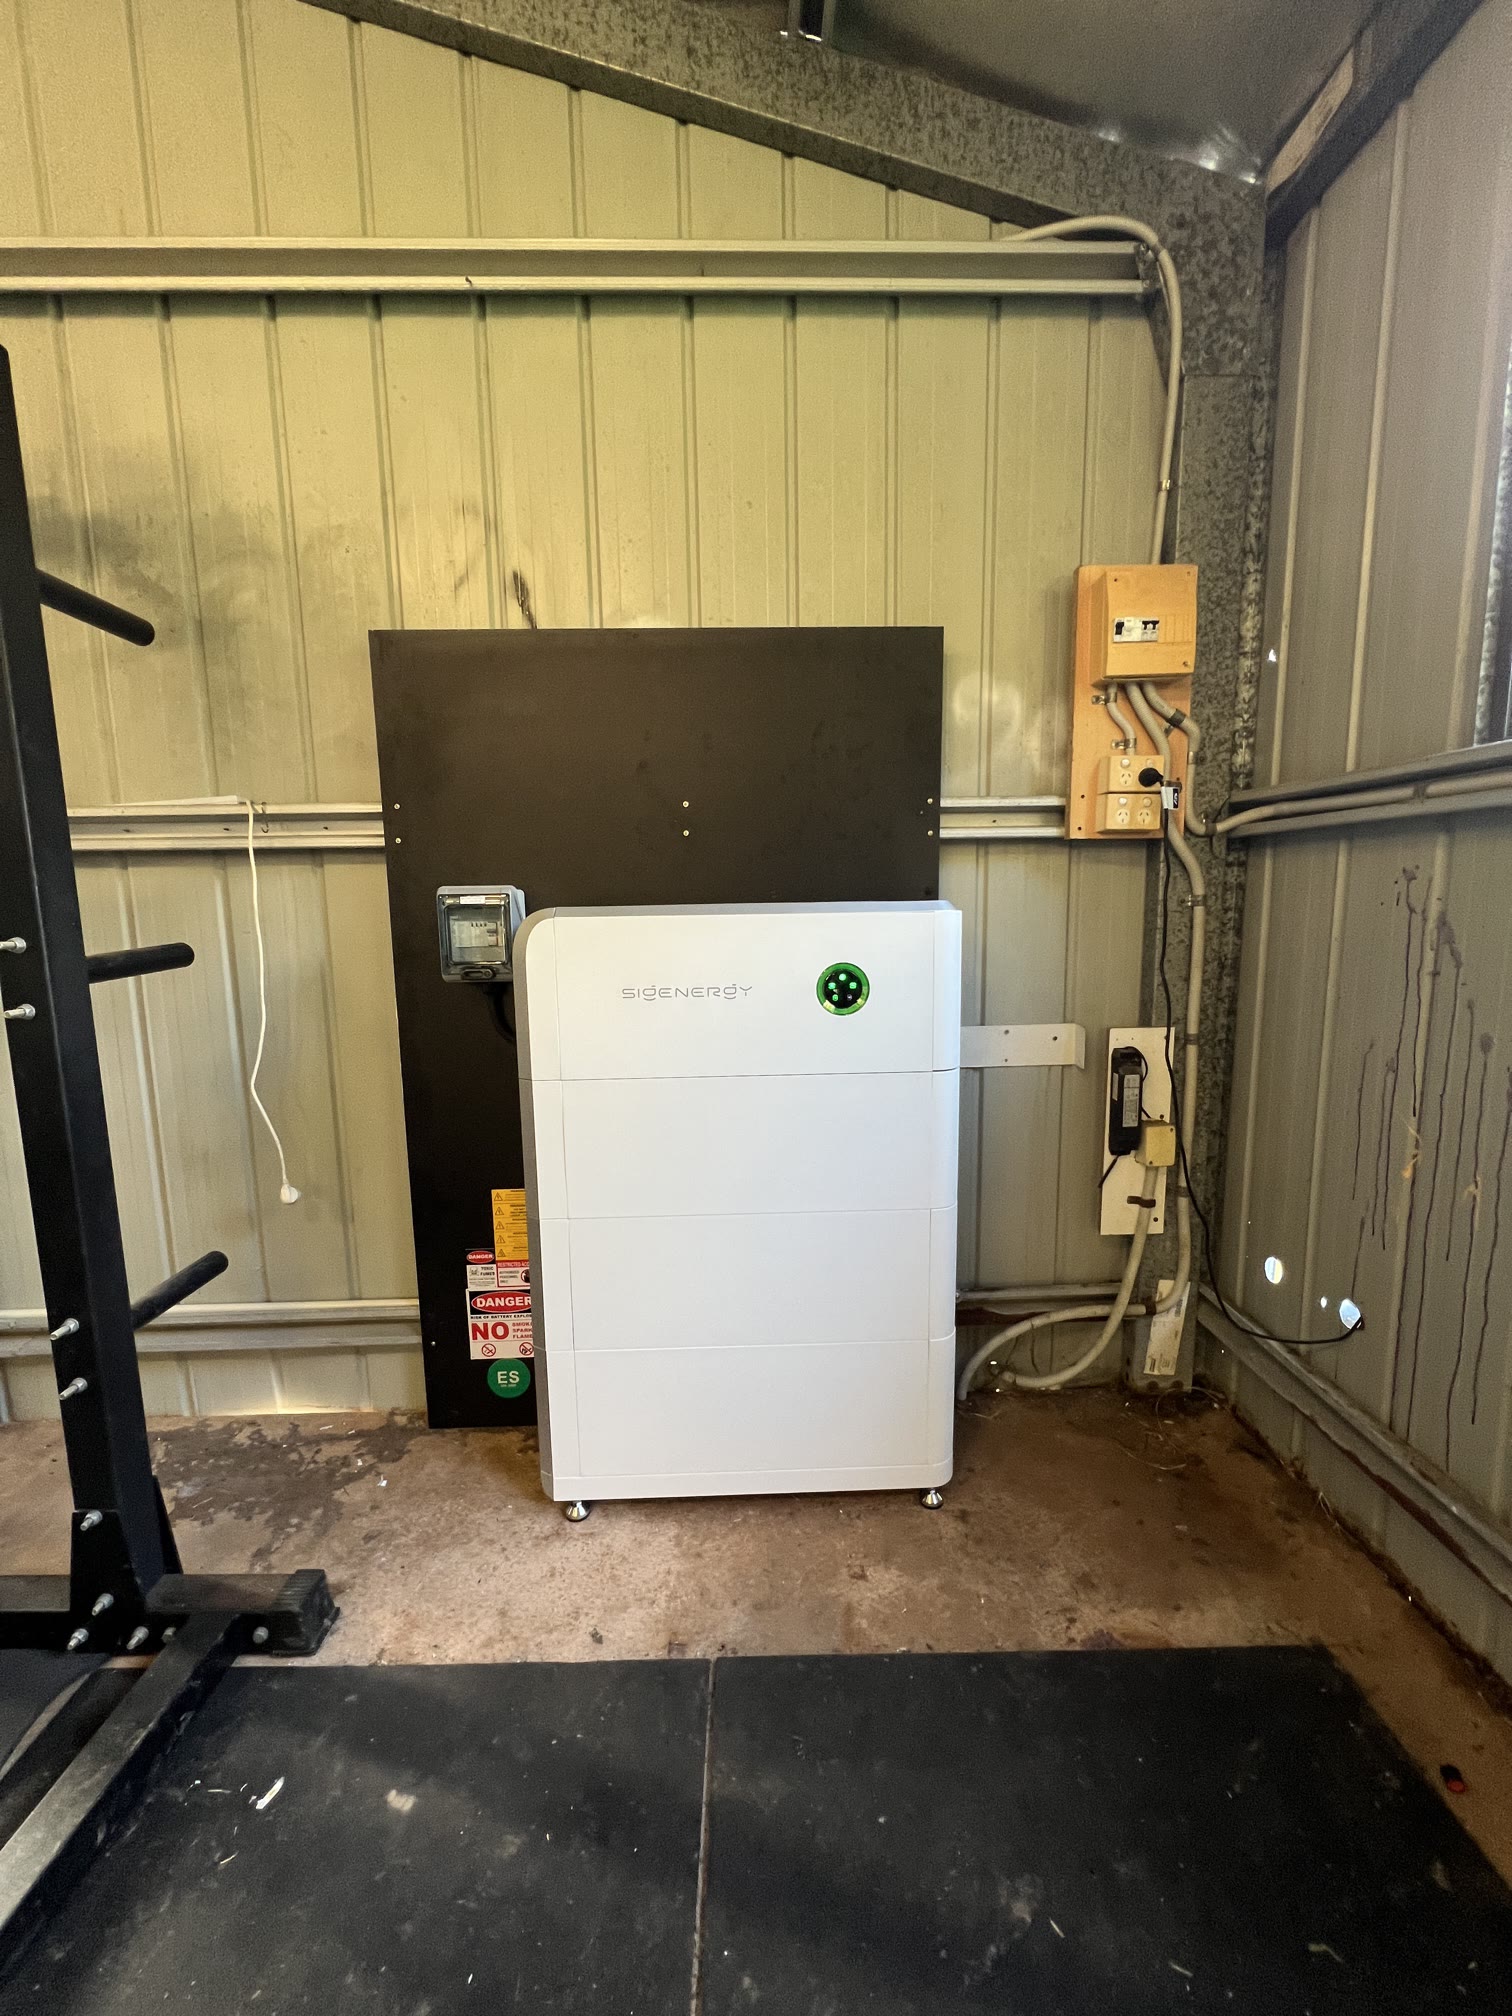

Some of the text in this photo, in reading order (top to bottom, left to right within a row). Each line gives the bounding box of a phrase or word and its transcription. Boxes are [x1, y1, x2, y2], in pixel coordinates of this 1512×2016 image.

[476, 1296, 532, 1308] DANGER
[471, 1321, 510, 1341] NO
[497, 1370, 520, 1384] ES
